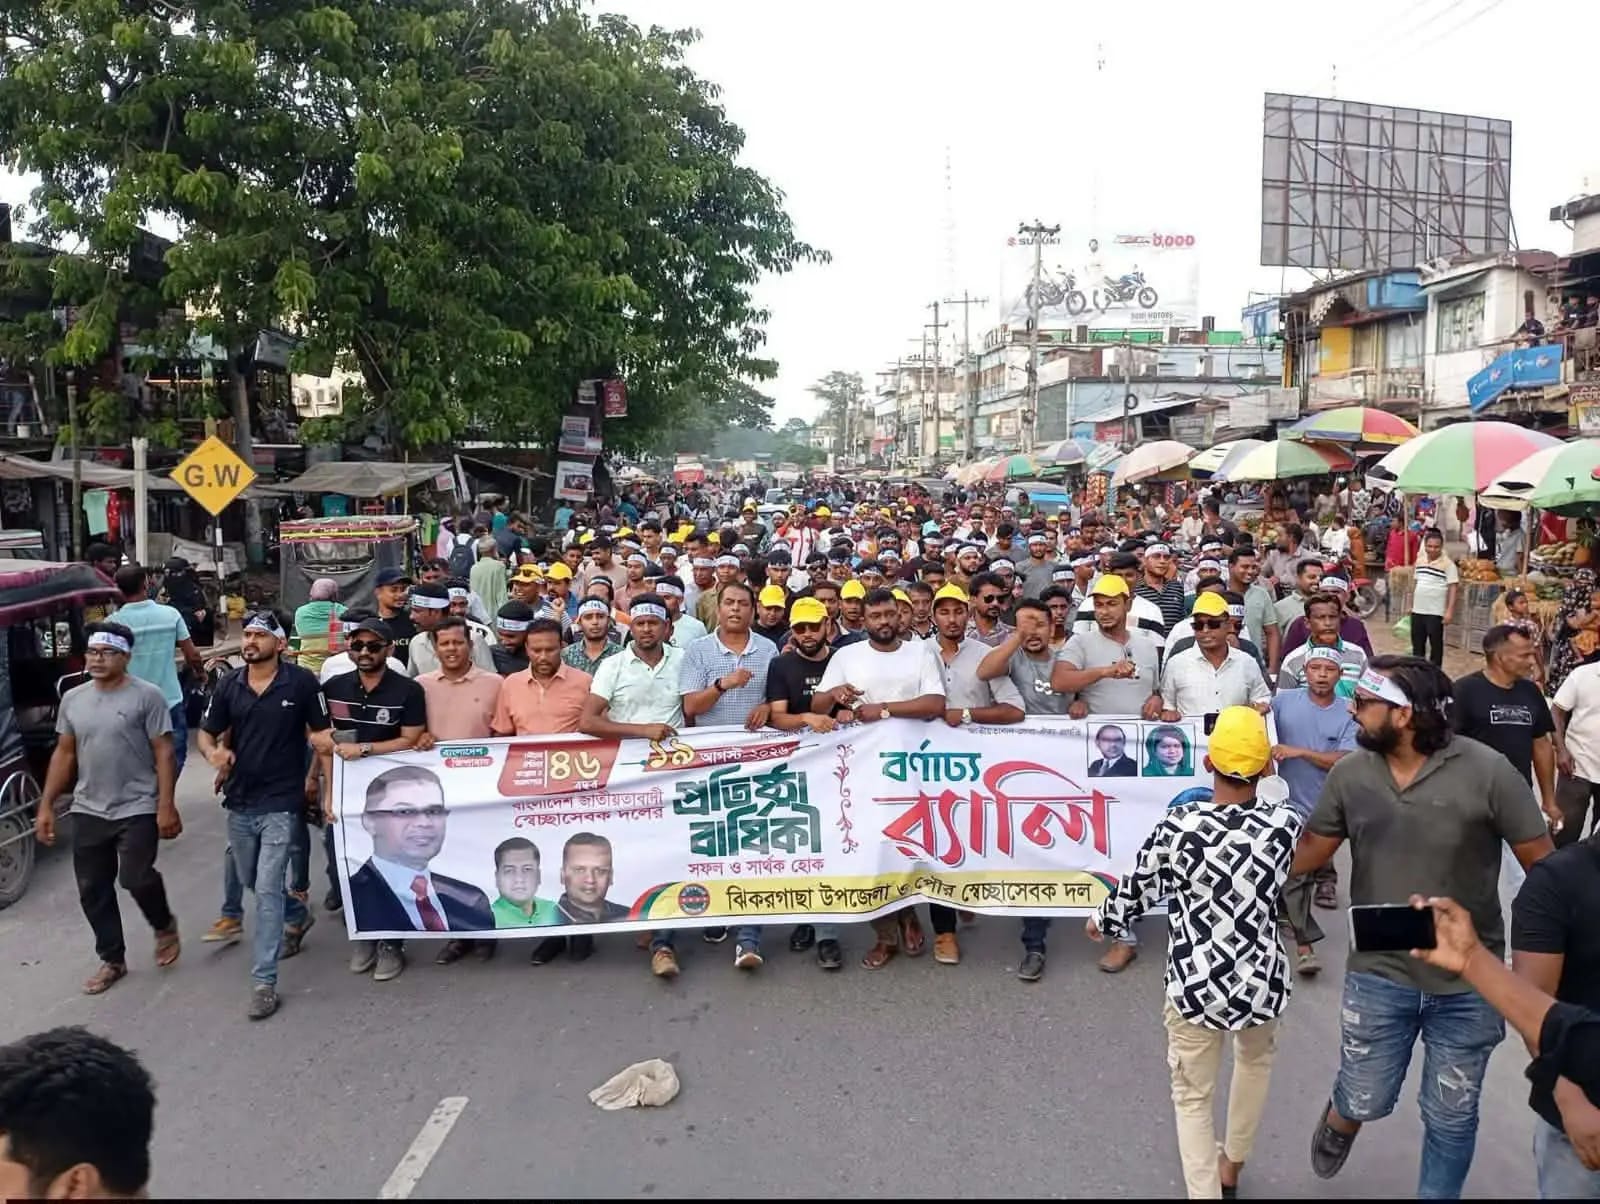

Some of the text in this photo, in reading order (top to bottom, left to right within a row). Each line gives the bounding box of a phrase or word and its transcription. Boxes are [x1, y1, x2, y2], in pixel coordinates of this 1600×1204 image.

[1018, 237, 1061, 246] SUUKI
[184, 464, 241, 488] G.W
[549, 750, 601, 780] ৪৬
[649, 738, 695, 768] ১৯
[699, 748, 743, 764] আগস্ট
[880, 739, 982, 783] বর্ণাঢ্য
[511, 786, 665, 813] বাংলাদেশ জাতীয়তাবাদী
[672, 763, 809, 816] প্রতিষ্ঠা
[513, 806, 665, 829] স্বেচ্ছাসেবক দলের
[689, 800, 822, 858] বার্ষিকী
[688, 854, 825, 877] সফল ও সার্থক হোক
[726, 884, 814, 911] ঝিকরগাছা
[818, 881, 891, 911] উপজেলা
[913, 875, 956, 898] পৌর
[961, 878, 1058, 904] স্বেচ্ছাসেবক
[1063, 881, 1092, 904] দল
